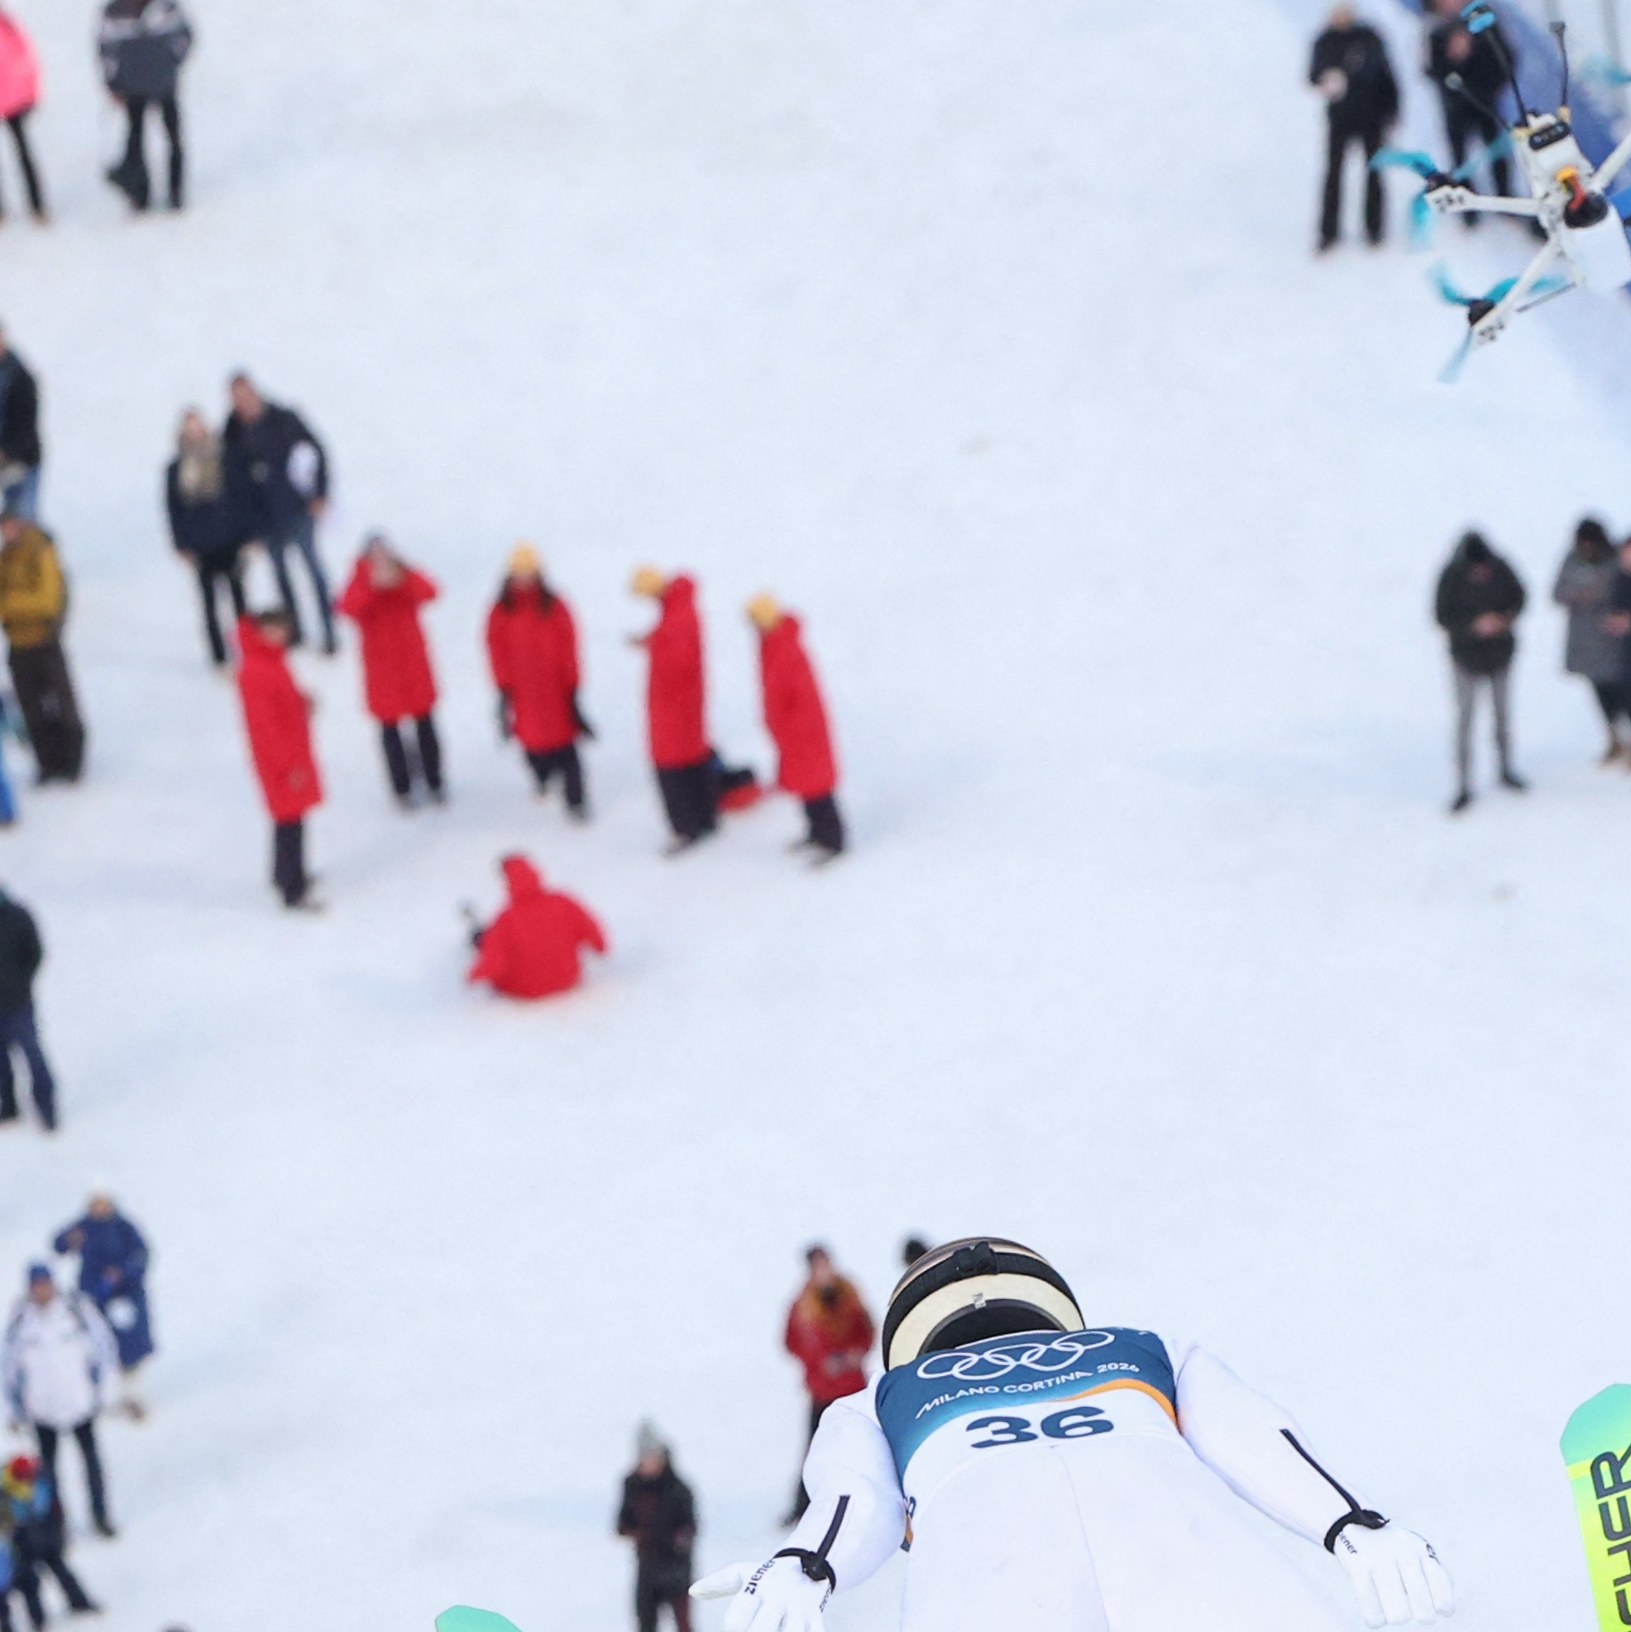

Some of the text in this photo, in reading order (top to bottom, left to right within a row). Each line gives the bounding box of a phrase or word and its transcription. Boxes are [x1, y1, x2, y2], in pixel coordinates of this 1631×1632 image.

[915, 1362, 1140, 1419] MILANO CORTINA 2026
[965, 1405, 1114, 1449] 36
